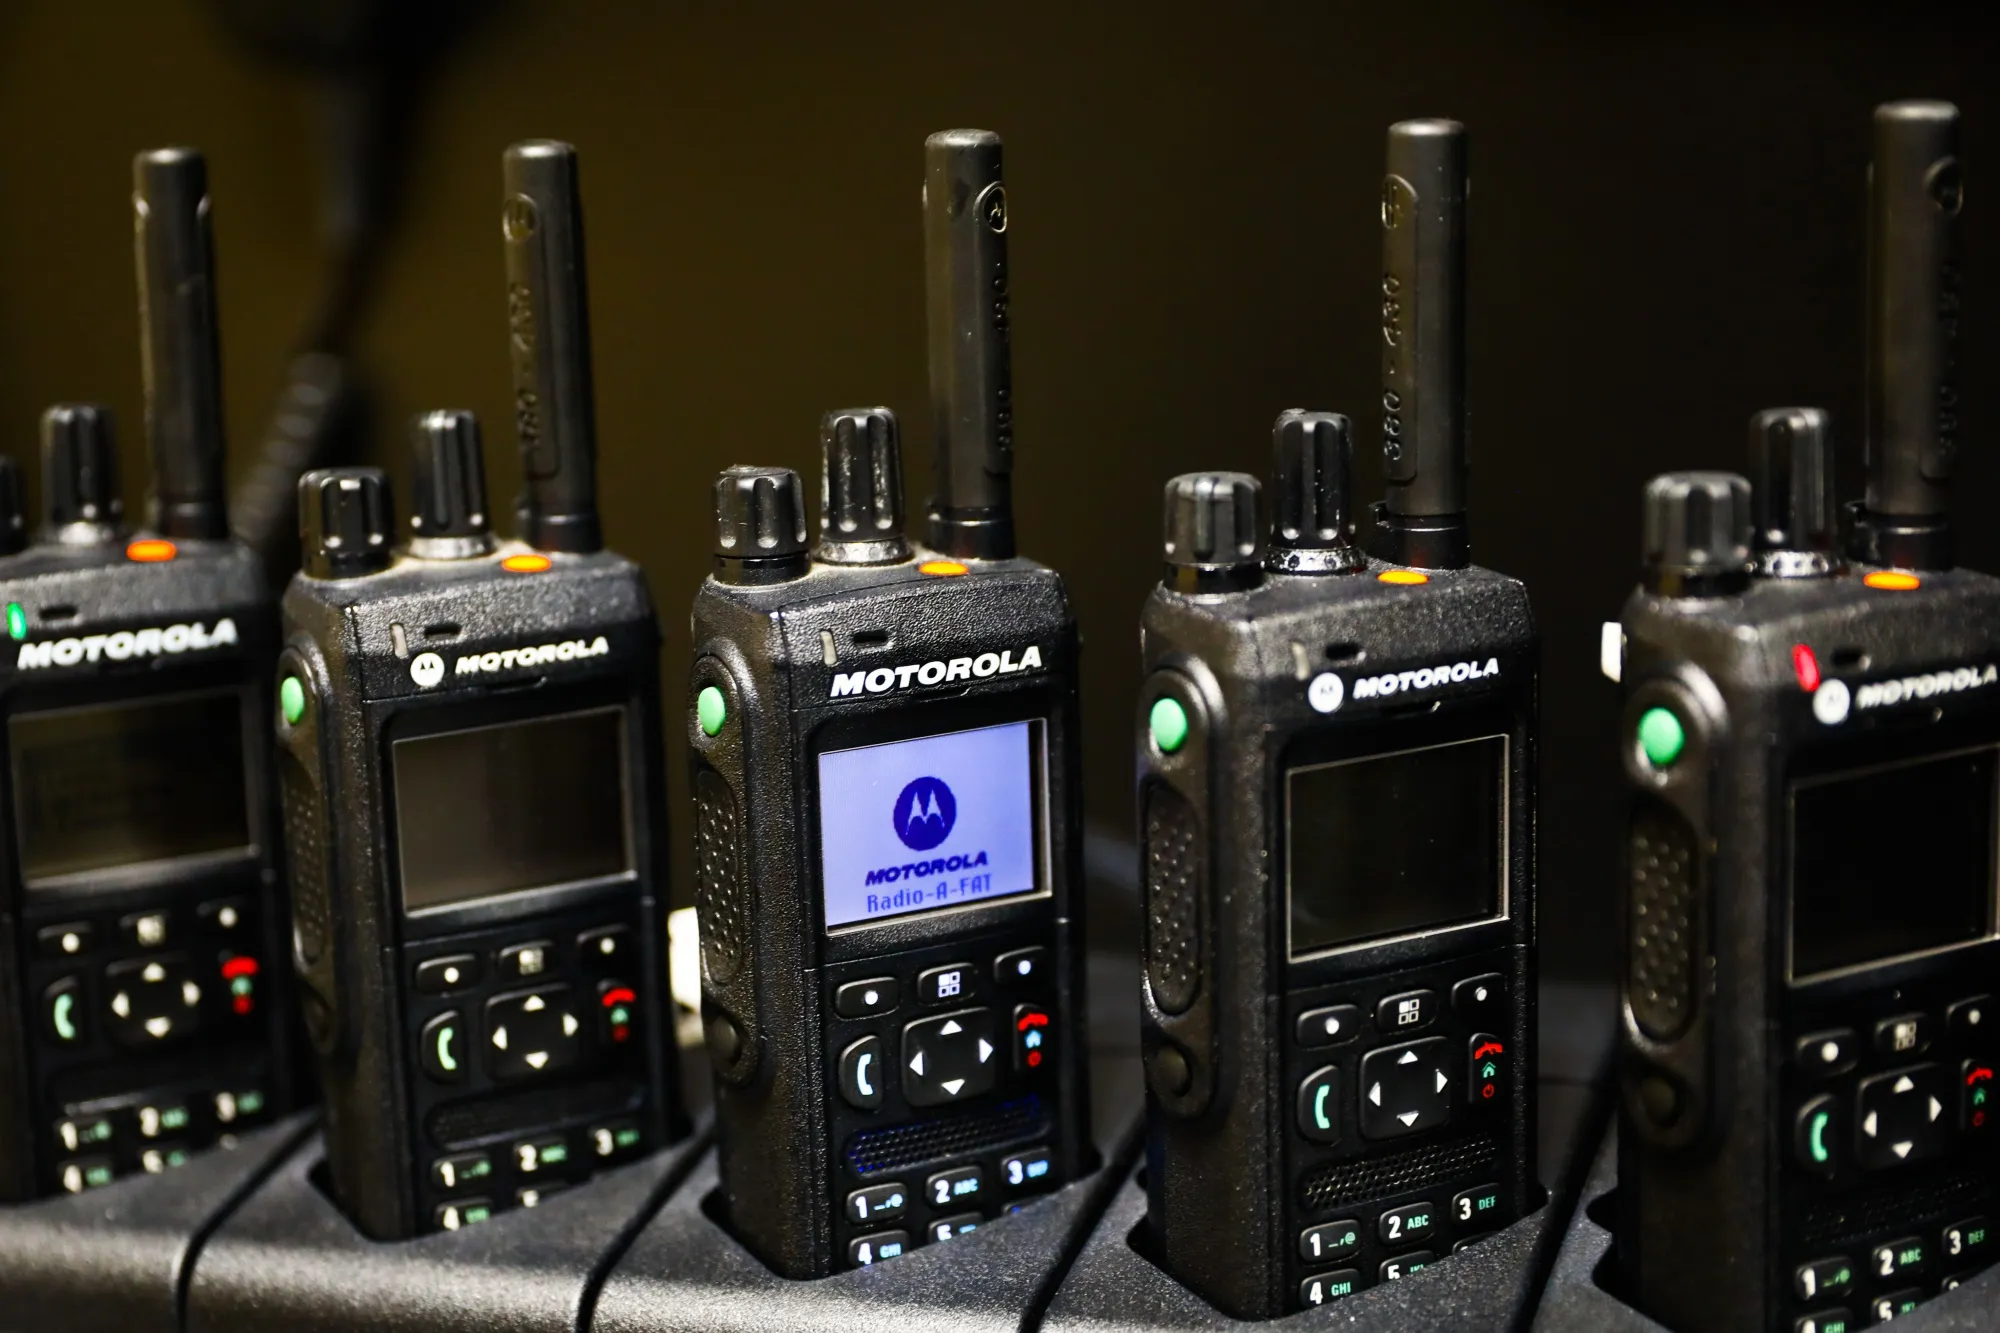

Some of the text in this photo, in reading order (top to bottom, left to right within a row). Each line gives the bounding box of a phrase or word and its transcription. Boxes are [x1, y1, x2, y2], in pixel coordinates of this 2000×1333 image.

[17, 618, 238, 670] MOTOROLA
[455, 636, 609, 675] MOTOROLA
[830, 646, 1043, 697] MOTOROLA
[1352, 657, 1499, 699] MOTOROLA
[1856, 663, 1998, 710] MOTOROLA
[865, 851, 988, 886] MOTOROLA
[867, 874, 992, 913] Radio-A-FAT
[1008, 1160, 1024, 1184] 3
[935, 1179, 951, 1204] 2
[855, 1196, 868, 1219] 1
[1459, 1196, 1496, 1221] 3 DEF
[1388, 1214, 1429, 1239] 2 ABC
[857, 1242, 902, 1265] 4 GHI
[1309, 1232, 1321, 1257] 1
[1949, 1229, 1961, 1255] 3
[1879, 1248, 1922, 1276] 2 ABC
[1309, 1281, 1351, 1305] 4 GHI
[1802, 1268, 1816, 1298] 1
